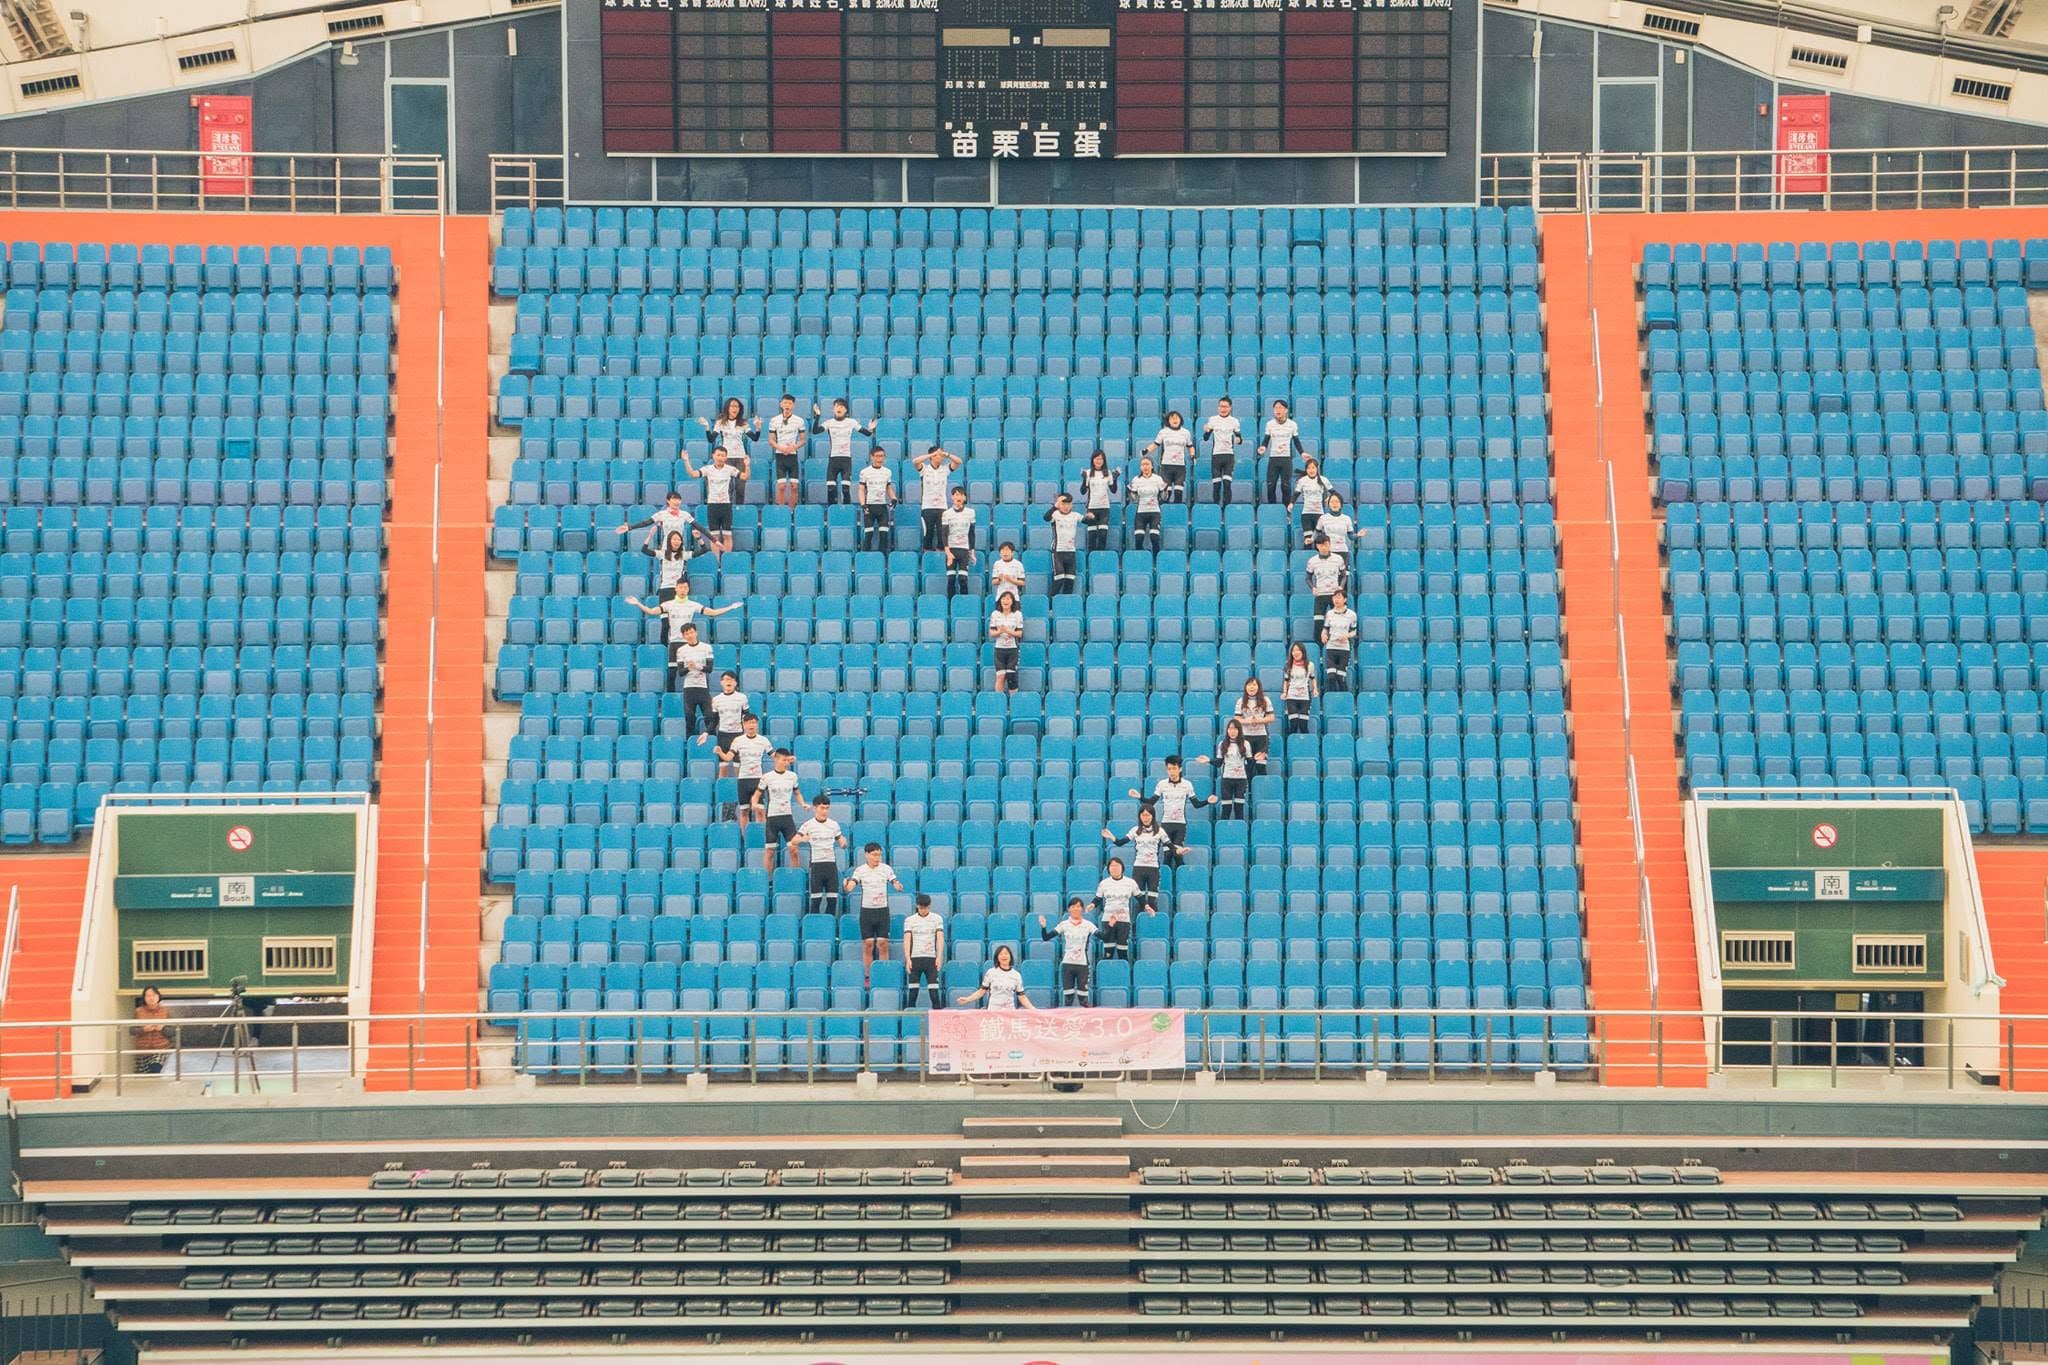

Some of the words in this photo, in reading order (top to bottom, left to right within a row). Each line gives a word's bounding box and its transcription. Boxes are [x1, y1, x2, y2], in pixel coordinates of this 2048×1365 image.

[951, 130, 1101, 158] 苗栗巨蛋
[228, 881, 246, 895] 南
[1824, 875, 1840, 889] 南
[223, 894, 251, 902] South
[979, 1016, 1133, 1042] 鐵馬送愛3.0
